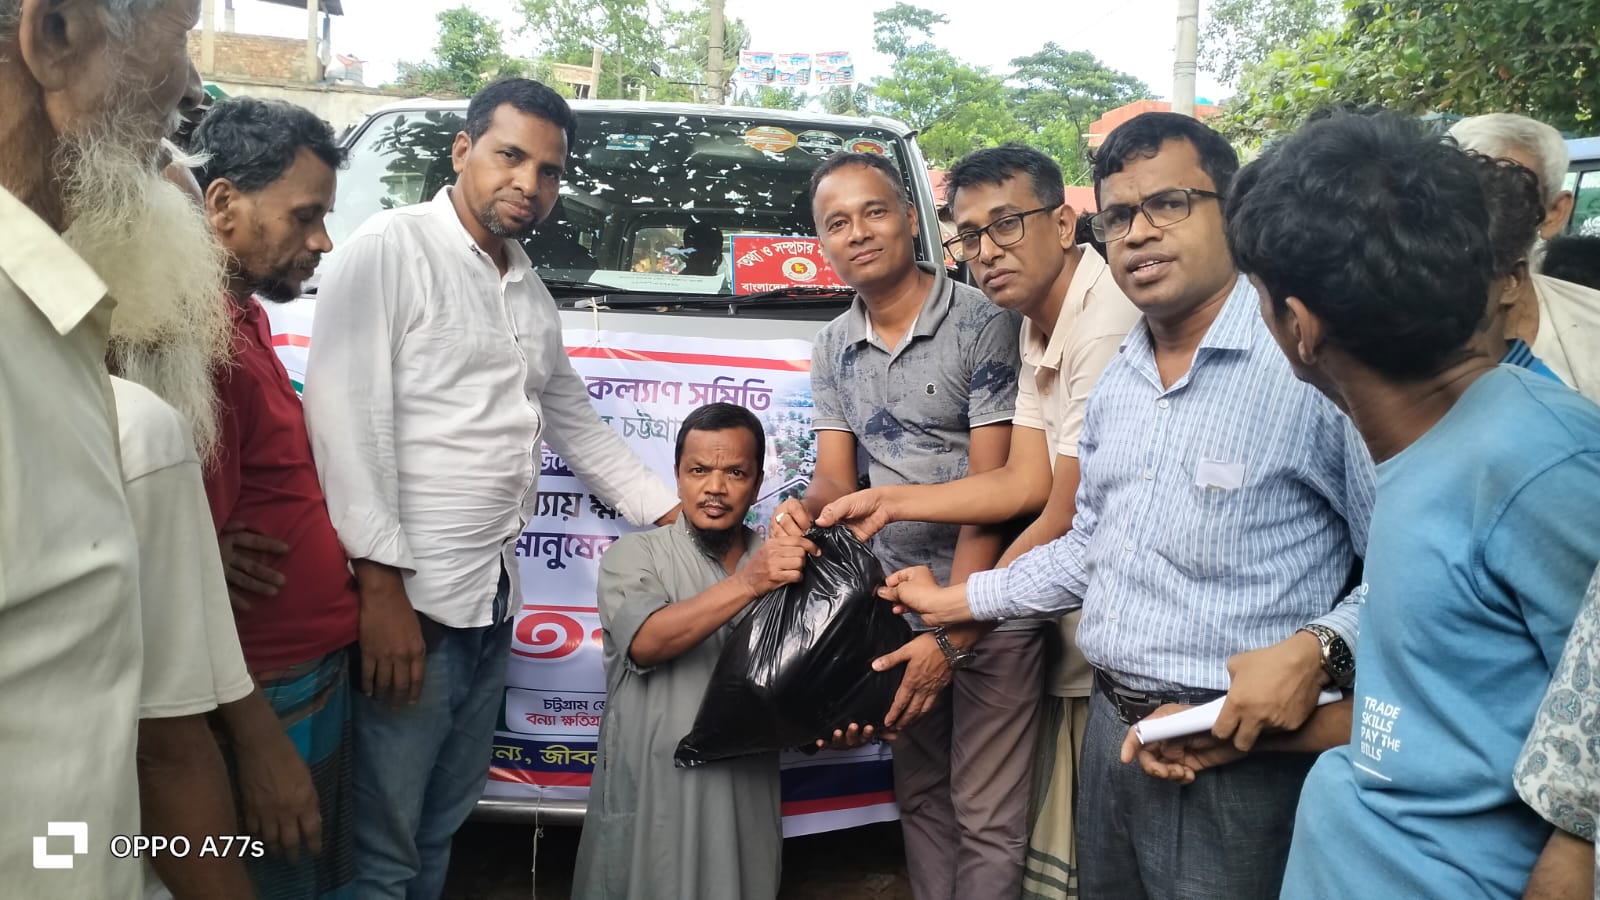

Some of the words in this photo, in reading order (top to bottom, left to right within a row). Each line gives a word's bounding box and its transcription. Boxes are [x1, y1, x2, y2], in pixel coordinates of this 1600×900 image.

[585, 375, 682, 405] কল্যাণ
[688, 375, 773, 411] সমিতি
[620, 408, 684, 443] চট্টগ্রা
[543, 697, 589, 712] চট্টগ্রাম
[1364, 696, 1400, 719] TRADE
[525, 713, 556, 726] বন্যা
[560, 712, 601, 727] ক্ষতিগ্র
[1361, 711, 1394, 733] SKILLS
[1361, 726, 1379, 743] PAY
[1381, 734, 1401, 752] THE
[492, 745, 532, 764] ন্য,
[1360, 741, 1382, 761] BILLS
